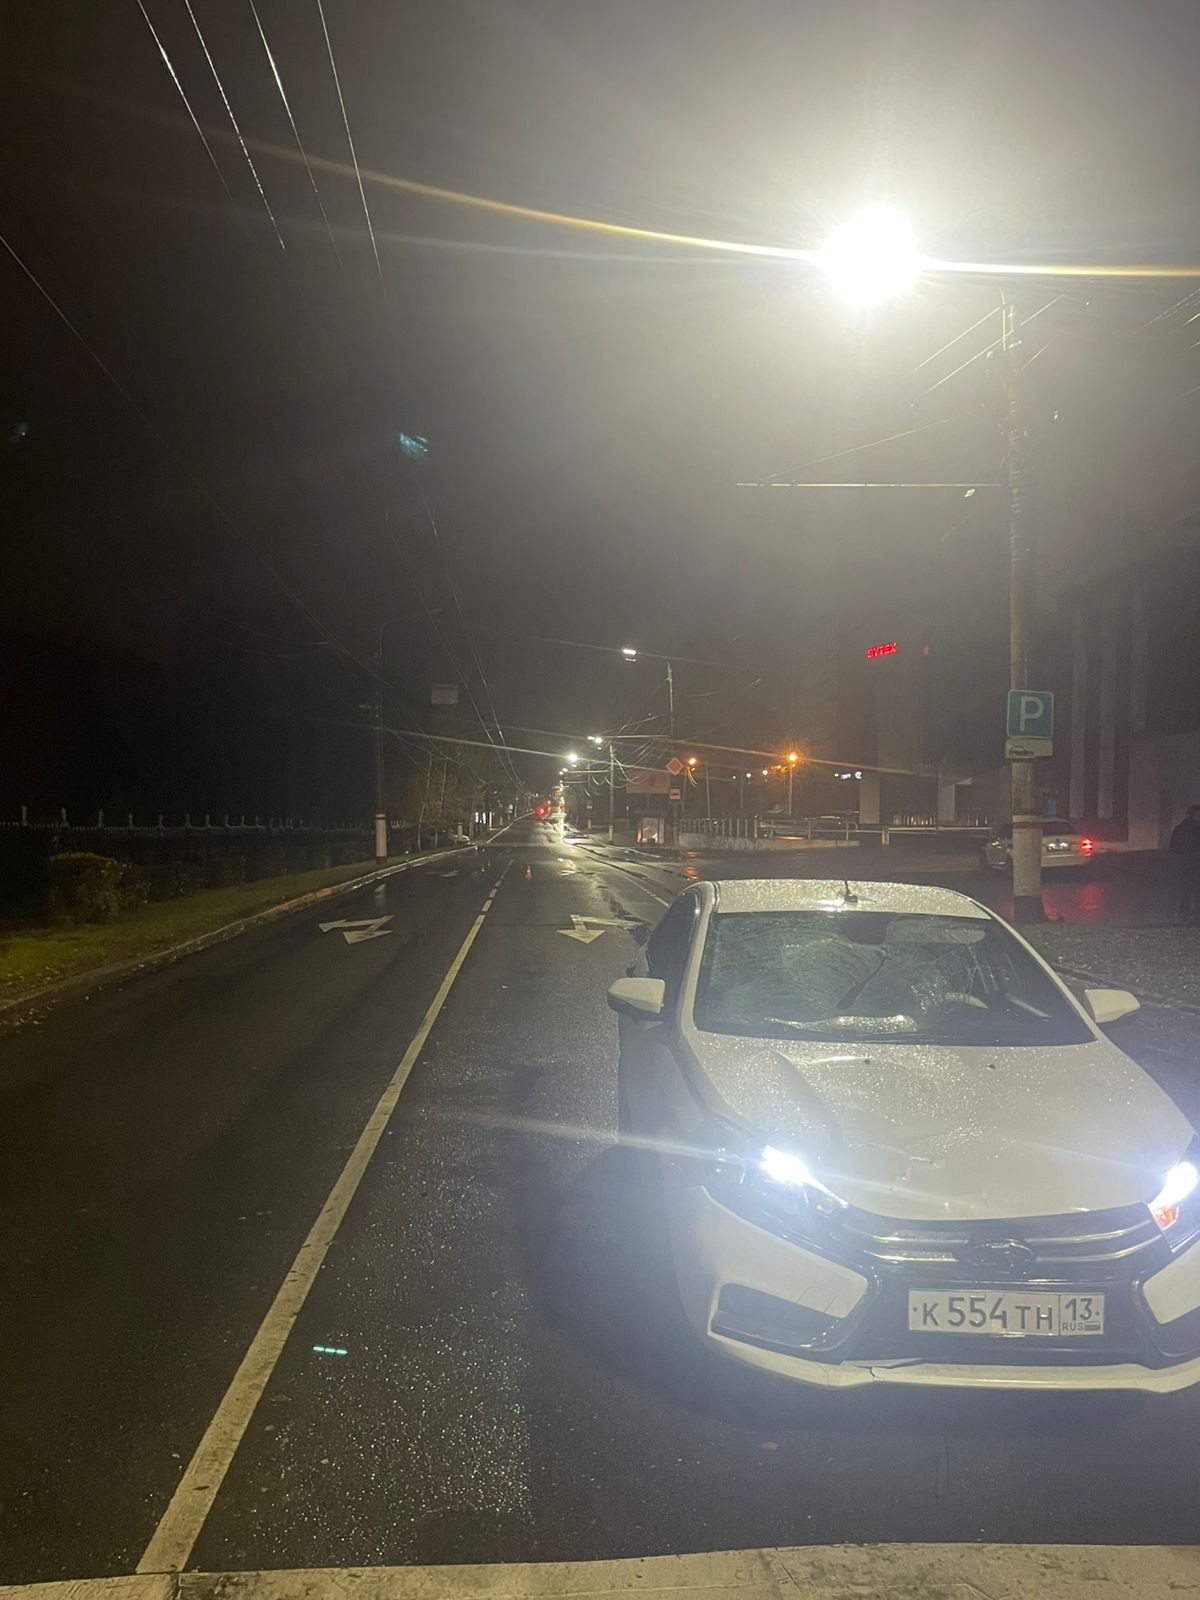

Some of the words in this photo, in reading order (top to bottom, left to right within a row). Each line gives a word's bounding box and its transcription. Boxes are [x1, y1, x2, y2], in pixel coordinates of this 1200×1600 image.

[1019, 695, 1044, 731] P
[1064, 1298, 1093, 1320] 13
[1062, 1323, 1084, 1331] RUS
